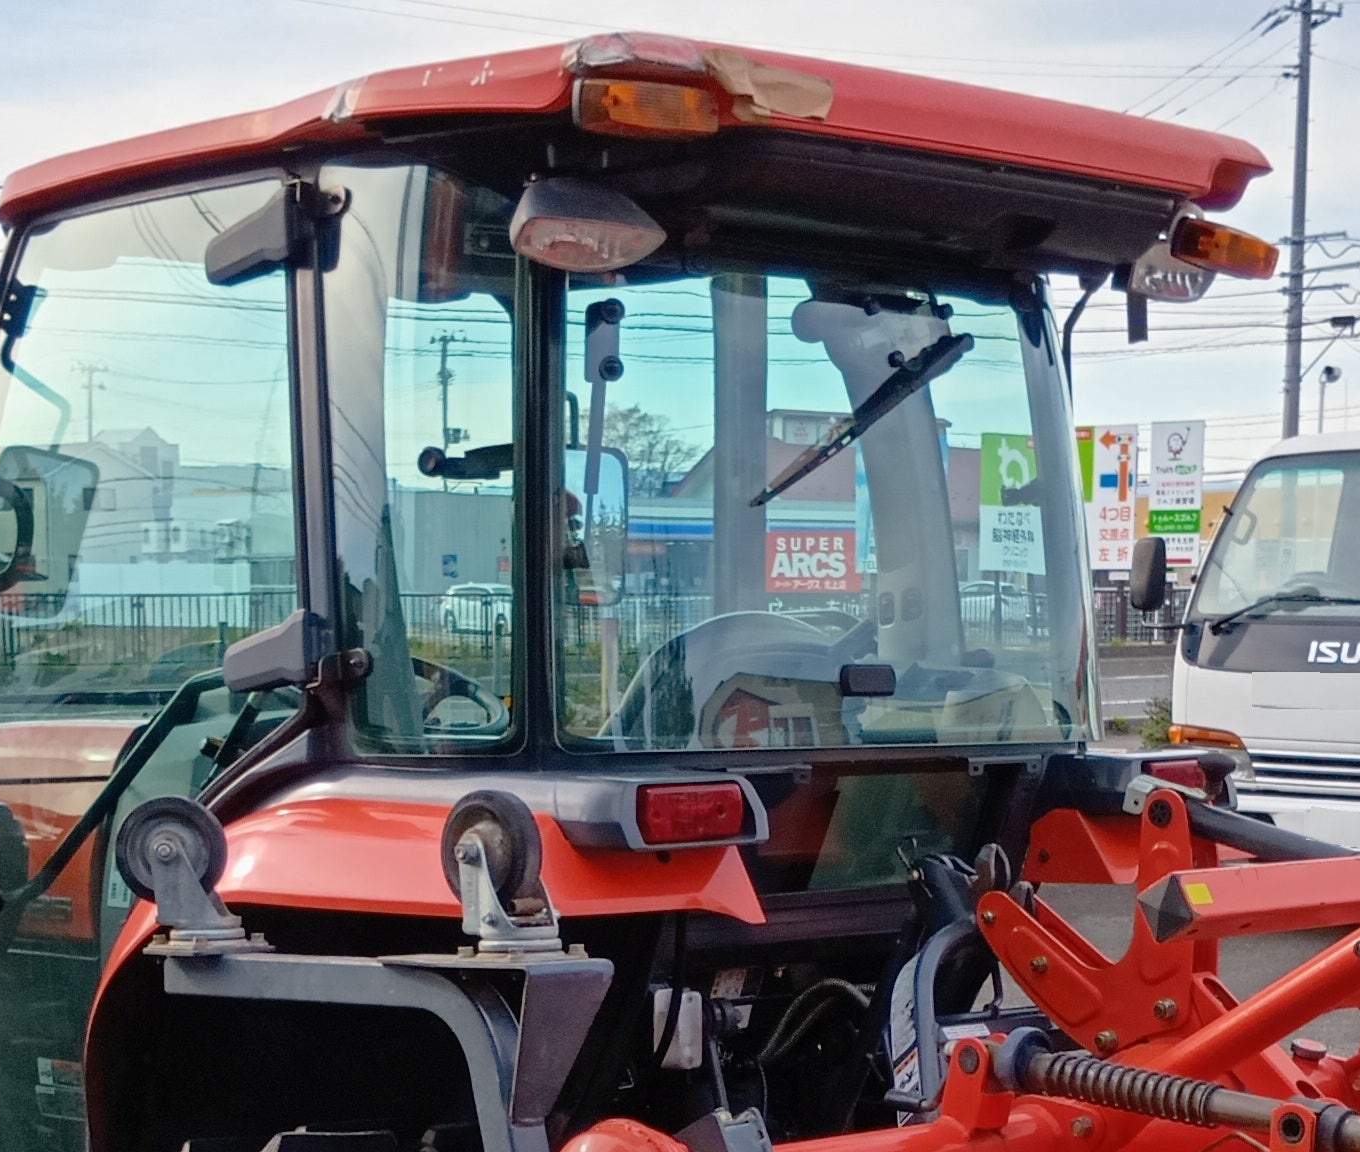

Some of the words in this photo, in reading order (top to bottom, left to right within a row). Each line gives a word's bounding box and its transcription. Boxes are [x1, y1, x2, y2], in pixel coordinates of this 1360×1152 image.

[1099, 506, 1131, 522] 4つ目
[776, 537, 844, 551] SUPER
[771, 552, 847, 578] ARCS
